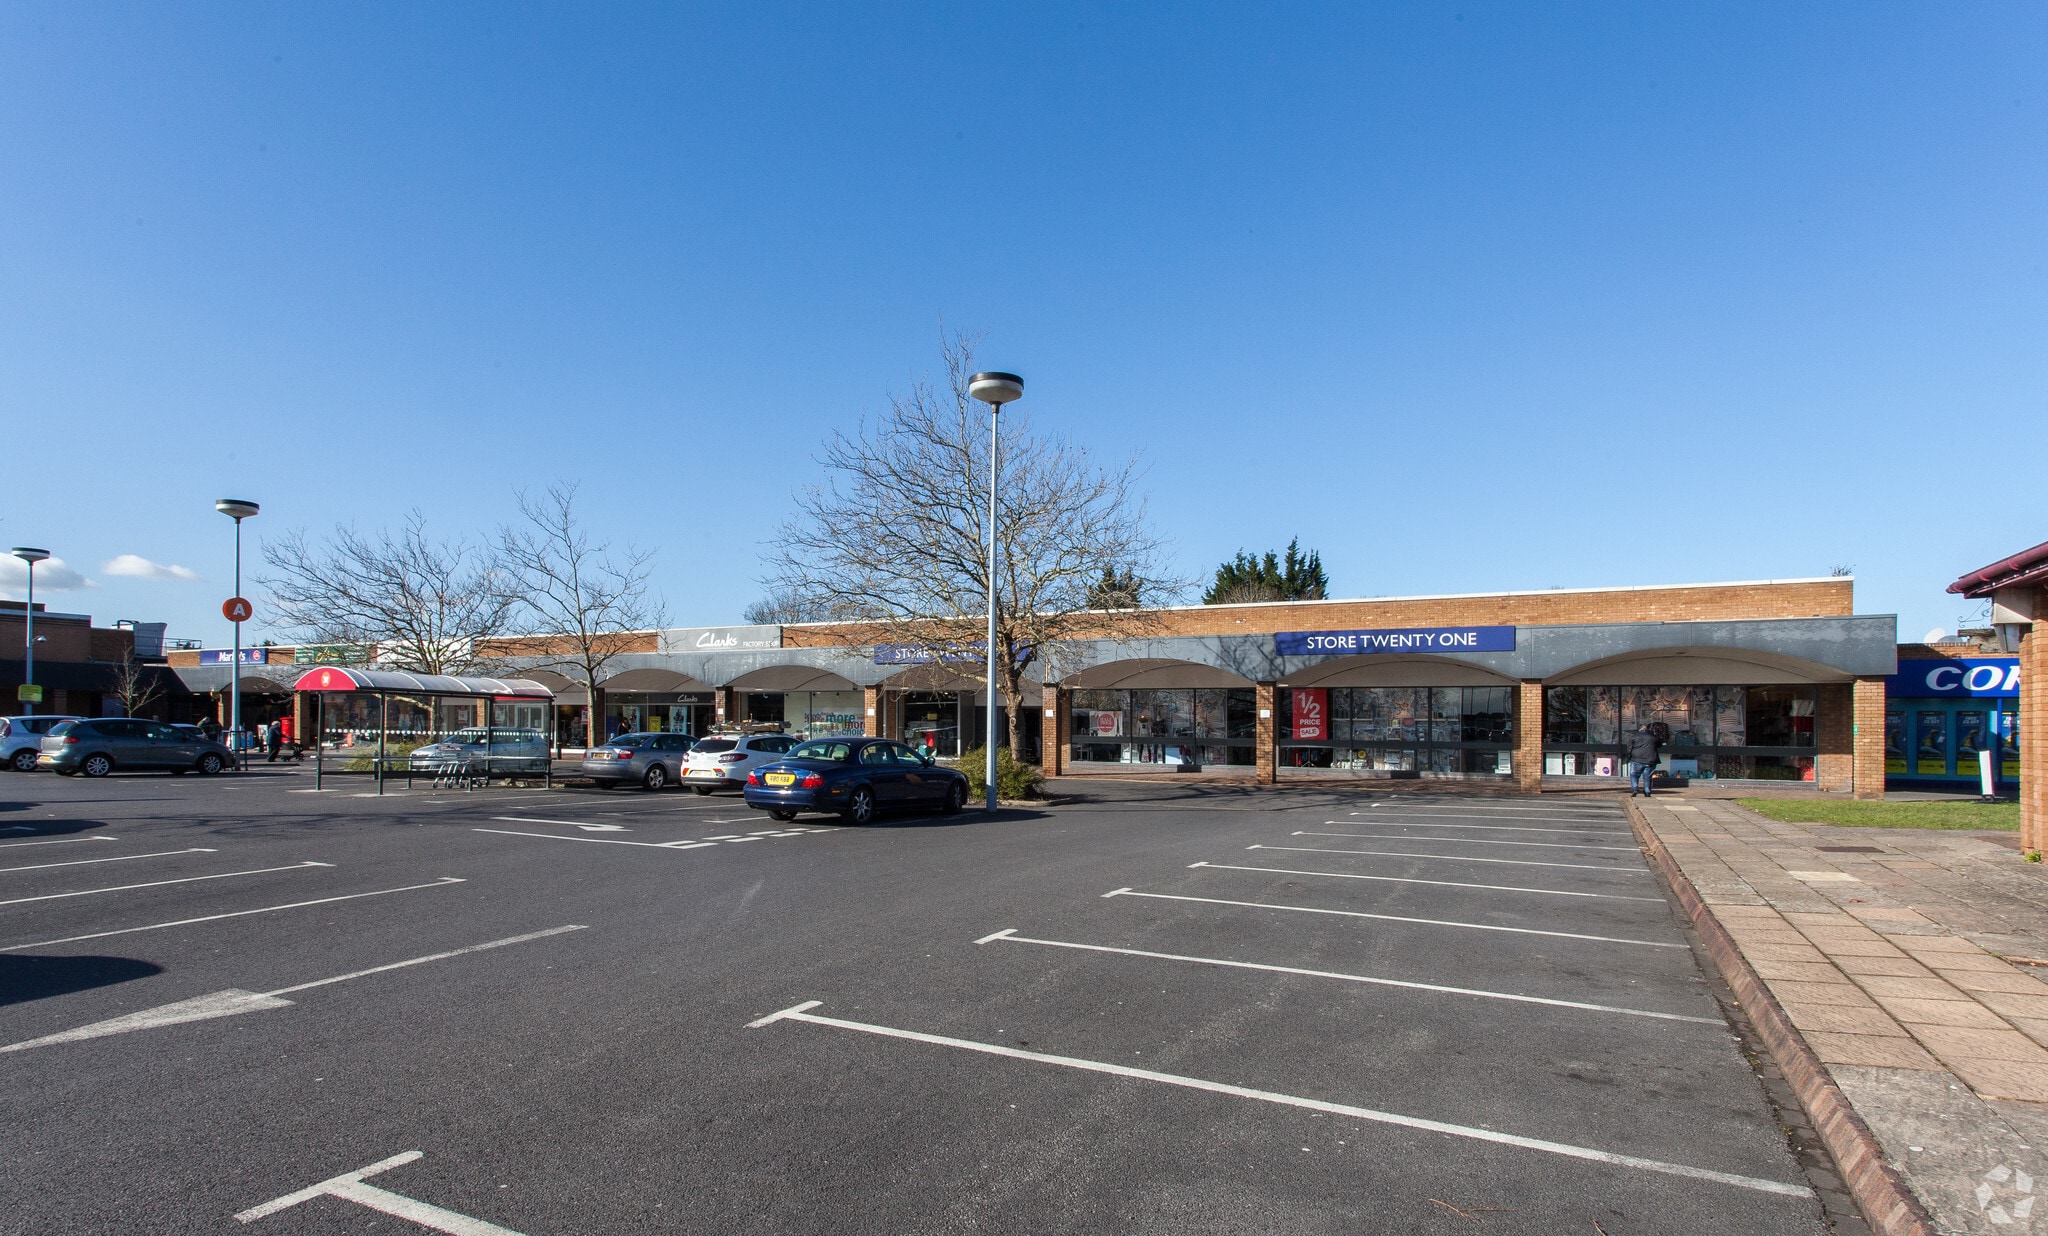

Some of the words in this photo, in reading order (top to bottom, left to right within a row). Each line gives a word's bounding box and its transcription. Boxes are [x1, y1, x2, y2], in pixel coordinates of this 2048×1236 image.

[233, 603, 246, 616] A
[696, 632, 737, 648] Clarks
[1307, 636, 1356, 649] STORE
[1360, 633, 1436, 648] TWENTY
[1439, 632, 1477, 646] ONE
[677, 694, 698, 703] Clarks
[826, 714, 855, 723] more
[845, 721, 865, 730] mor
[1301, 728, 1317, 736] SALE
